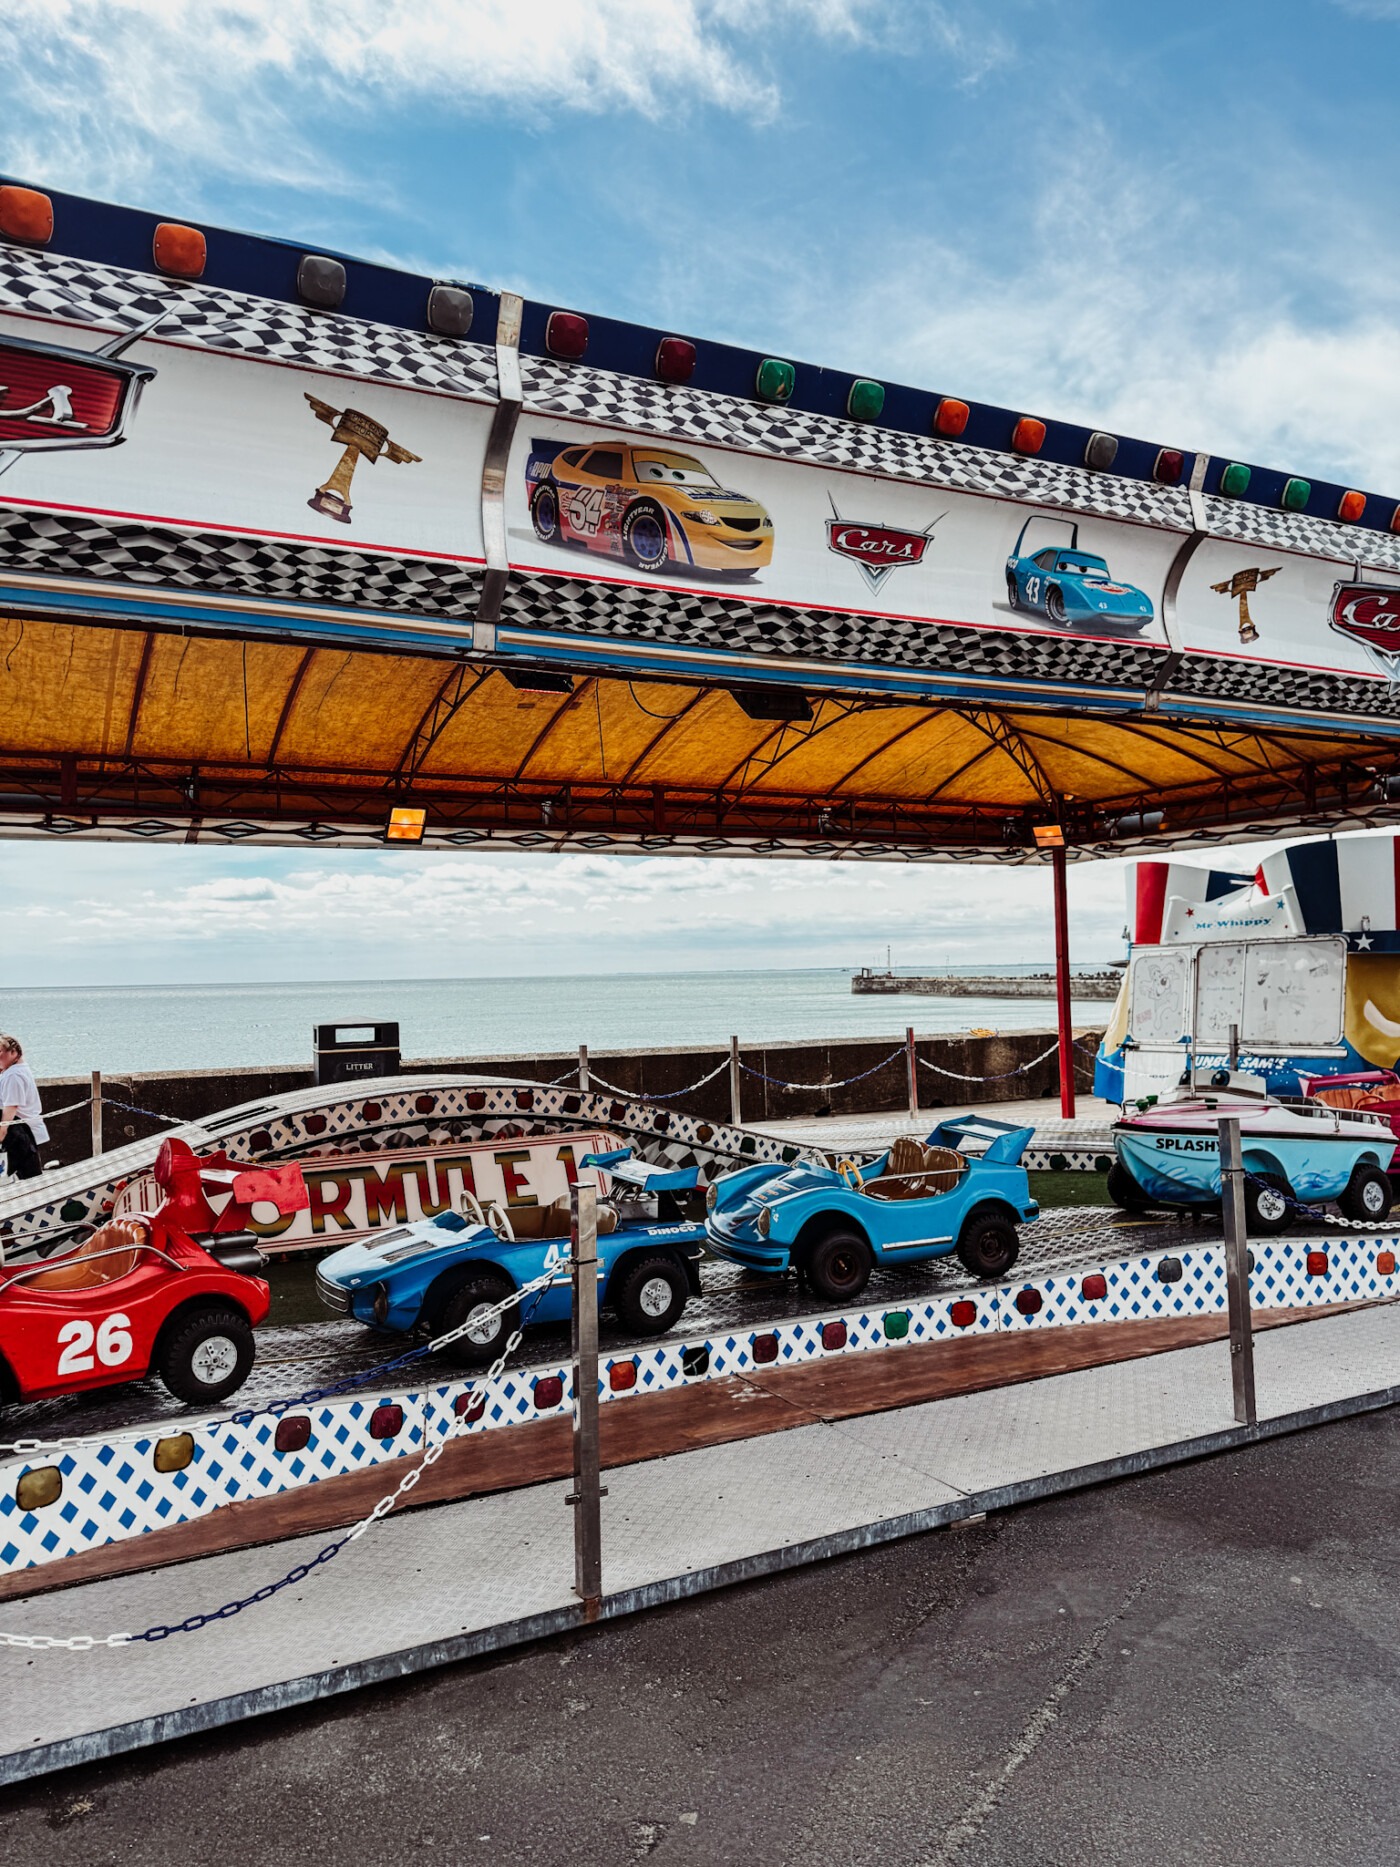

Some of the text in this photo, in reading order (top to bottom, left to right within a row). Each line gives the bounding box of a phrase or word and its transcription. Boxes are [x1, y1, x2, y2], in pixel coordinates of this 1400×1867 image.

[837, 529, 914, 558] Cars
[1026, 576, 1040, 604] 43
[1342, 595, 1400, 631] Ca
[1217, 918, 1271, 927] Whippy
[345, 1062, 373, 1070] LITTER
[1195, 1055, 1287, 1070] UNCL SAM'S
[242, 1150, 539, 1238] ORMULE
[647, 1225, 697, 1236] DINOCO
[57, 1313, 133, 1376] 26
